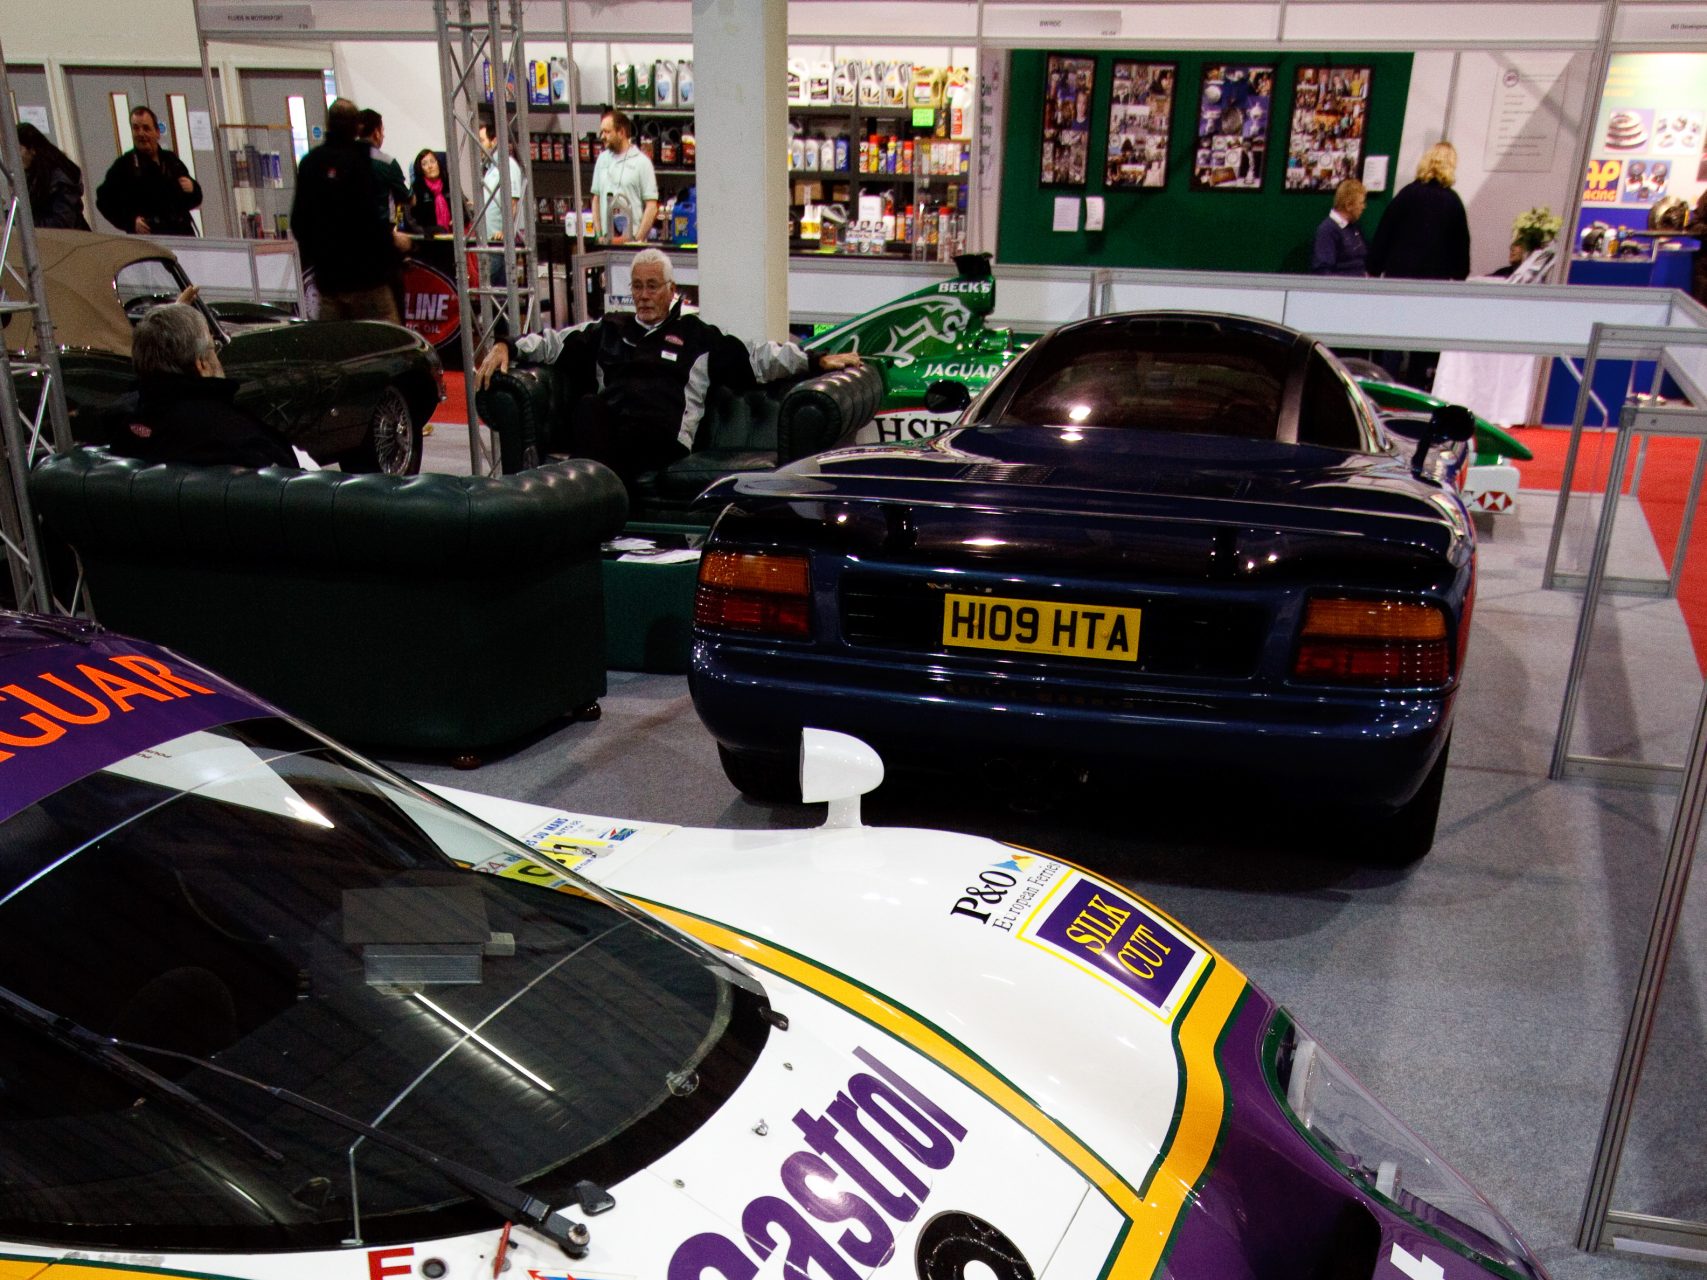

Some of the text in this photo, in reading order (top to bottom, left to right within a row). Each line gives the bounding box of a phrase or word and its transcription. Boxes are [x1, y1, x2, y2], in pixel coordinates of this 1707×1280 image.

[938, 280, 992, 294] BECK'S
[922, 363, 1001, 379] JAGUAR
[1052, 608, 1129, 653] HTA
[0, 655, 217, 763] GUAR
[950, 870, 1018, 925] P&O
[992, 862, 1061, 932] European Ferries
[1065, 893, 1132, 955] SILK
[1117, 923, 1172, 979] CUT
